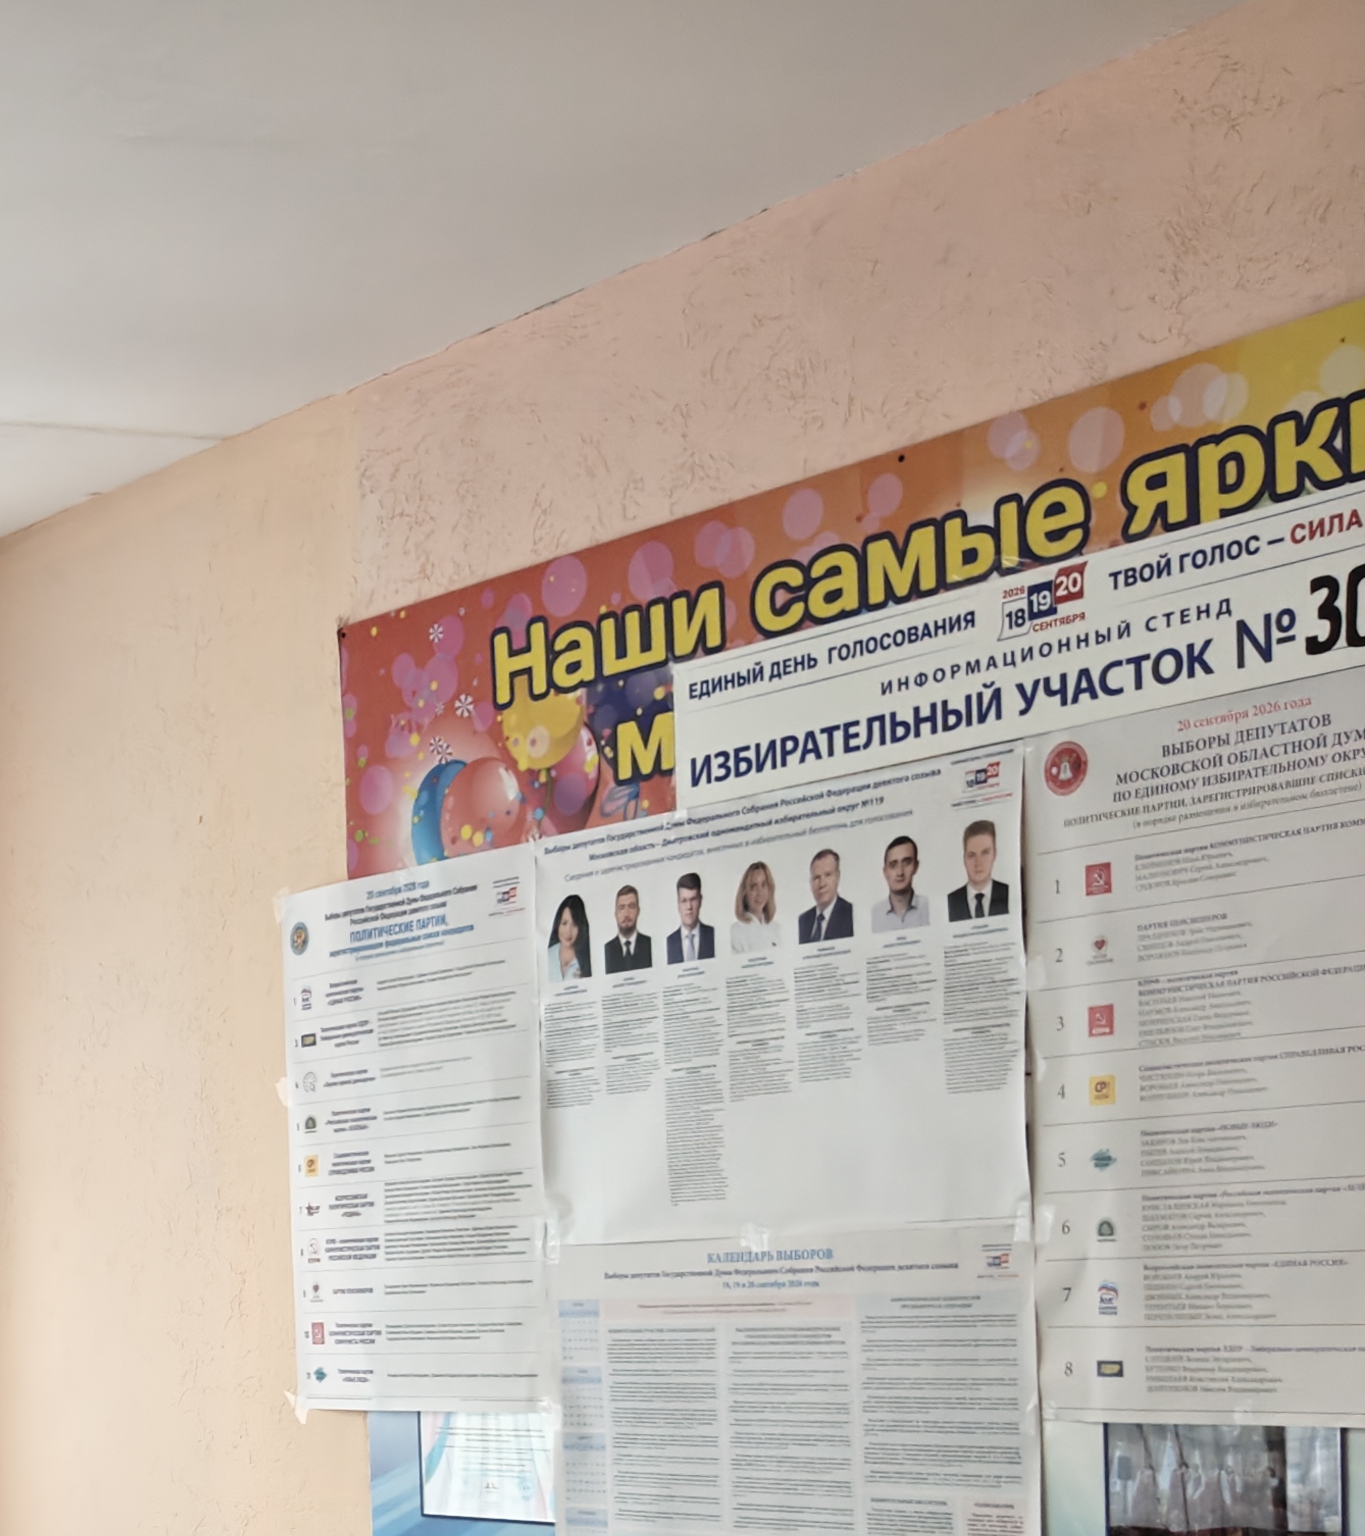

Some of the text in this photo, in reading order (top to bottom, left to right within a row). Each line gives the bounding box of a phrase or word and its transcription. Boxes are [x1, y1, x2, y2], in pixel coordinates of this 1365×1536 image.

[1108, 554, 1172, 590] ТВОЙ
[1178, 535, 1261, 573] ГОЛОС
[1290, 509, 1364, 544] СИЛА
[492, 584, 724, 707] Наши
[753, 480, 1090, 636] самые
[1002, 585, 1025, 599] 2026
[1006, 572, 1082, 629] 18 19 20
[1032, 612, 1085, 632] СЕНТЯБРЯ
[688, 611, 976, 699] ЕДИНЫЙ ДЕНЬ ГОЛОСОВАНИЯ
[881, 598, 1233, 696] ИНФОРМАЦИОННЫЙ СТЕНД
[690, 683, 1004, 788] ИЗБИРАТЕЛЬНЫЙ
[1015, 638, 1215, 717] УЧАСТОК
[1236, 607, 1297, 669] №
[1177, 698, 1312, 731] 20 сентября 2026 года
[1161, 713, 1332, 758] ВЫБОРЫ ДЕПУТАТОВ
[1116, 752, 1222, 786] МОСКОВСКОЙ
[1227, 735, 1328, 765] ОБЛАСТНОЙ
[1113, 789, 1131, 802] ПО
[1134, 777, 1199, 801] ЕДИНОМУ
[1201, 756, 1328, 787] ИЗБИРАТЕЛЬНОМУ
[1064, 806, 1140, 827] ПОЛИТИЧЕСКИЕ
[1189, 777, 1316, 809] ЗАРЕГИСТРИРОВАВШИЕ
[349, 920, 414, 943] ПОЛИТИЧЕСКИЕ
[1055, 948, 1063, 963] 2
[1056, 1017, 1065, 1031] 3
[1057, 1085, 1066, 1099] 4
[1057, 1153, 1066, 1167] 5
[1062, 1220, 1070, 1234] 6
[706, 1248, 834, 1264] КАЛЕНДАРЬ ВЫБОРОВ
[1063, 1287, 1072, 1302] 7
[1064, 1361, 1073, 1376] 8
